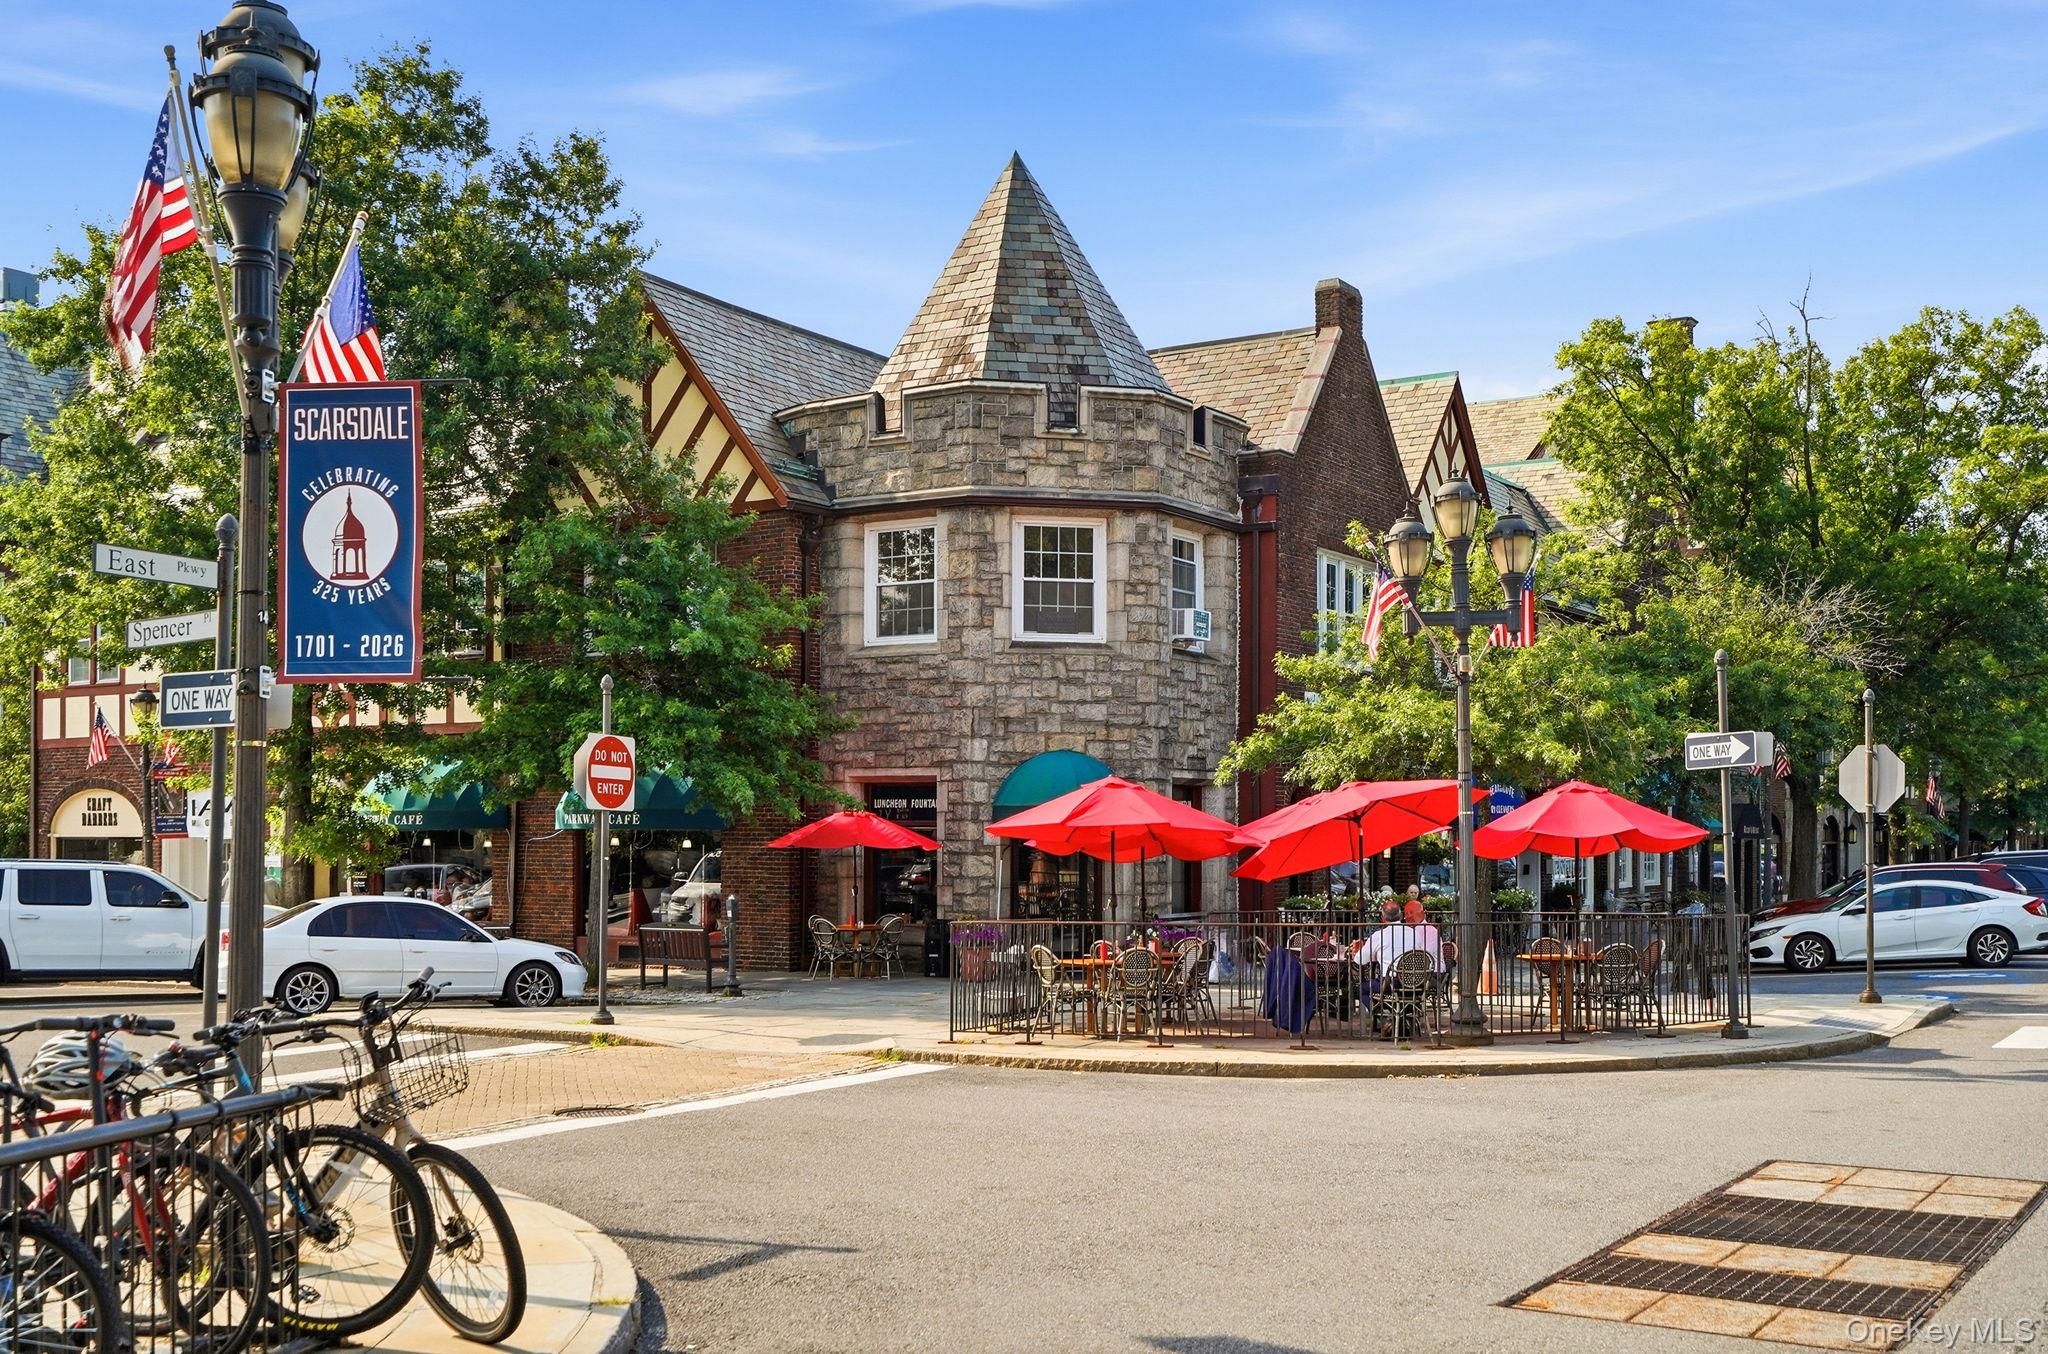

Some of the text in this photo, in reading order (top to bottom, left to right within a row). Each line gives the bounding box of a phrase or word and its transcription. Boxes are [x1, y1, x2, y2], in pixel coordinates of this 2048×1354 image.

[294, 406, 409, 441] SCARSDALE
[301, 466, 399, 502] CELEBRATING
[108, 549, 207, 578] East Pkwy
[312, 577, 392, 605] 325 YEARS
[133, 612, 212, 647] Spencer Pl
[295, 634, 335, 658] 1701
[360, 634, 404, 657] 2026
[171, 687, 232, 711] ONE WAY
[595, 749, 628, 764] DO NOT
[1692, 743, 1731, 759] ONE WAY
[597, 782, 624, 795] ENTER
[87, 797, 113, 812] CRAFT
[874, 798, 937, 809] LUNCHEON FOUNTA
[81, 812, 118, 827] BARBERS
[394, 812, 423, 825] CAFÉ
[564, 811, 641, 825] PARKWA CAFÉ
